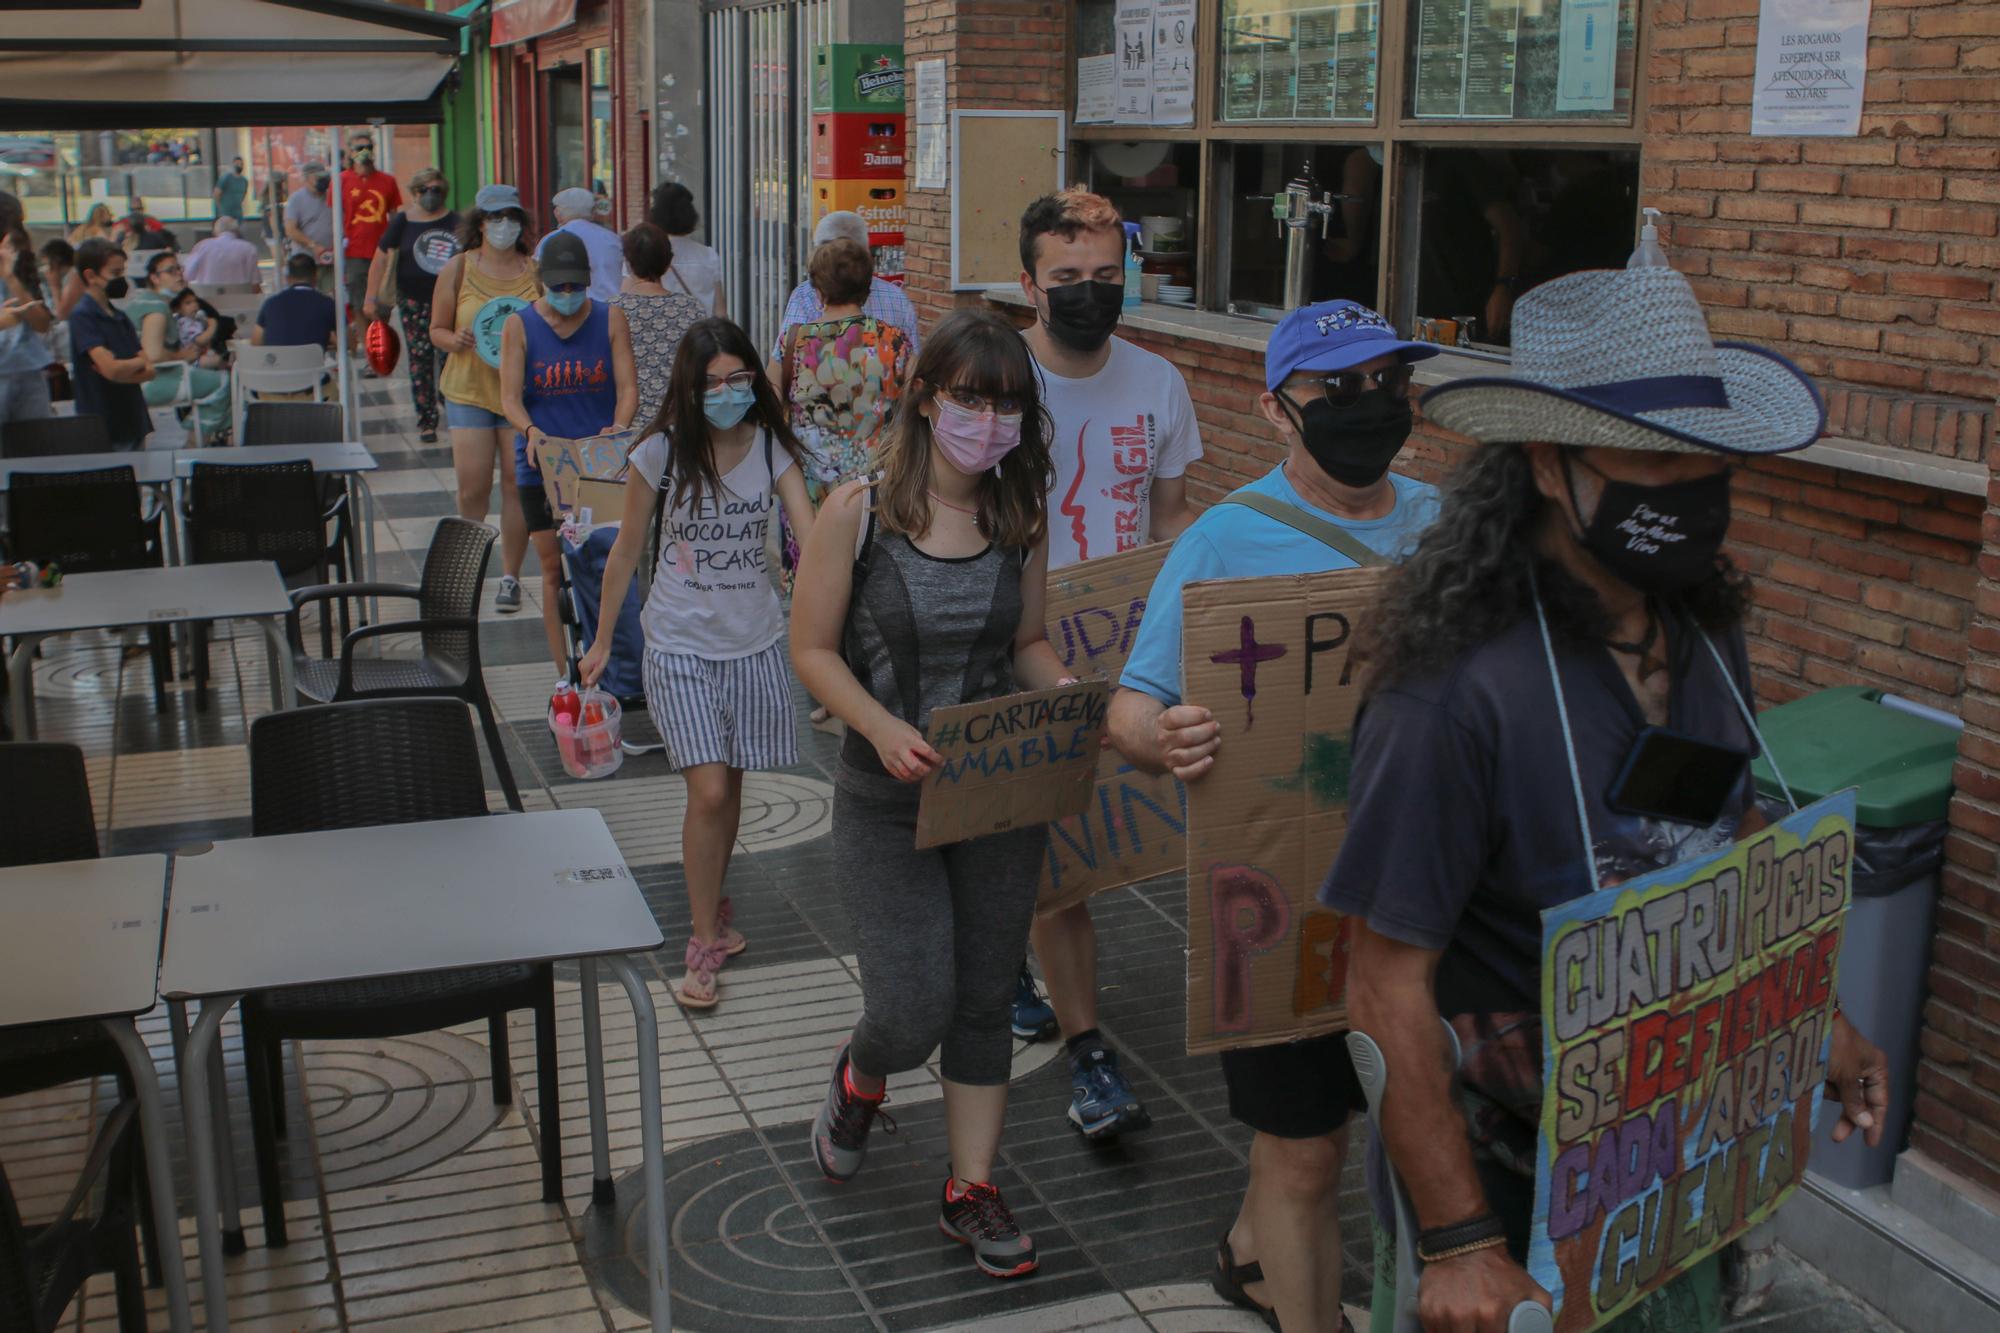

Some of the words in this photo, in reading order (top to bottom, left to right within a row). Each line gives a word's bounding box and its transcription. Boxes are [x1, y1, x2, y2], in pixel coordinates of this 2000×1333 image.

[1781, 35, 1795, 47] LES
[1797, 32, 1842, 46] ROGAMOS
[1825, 51, 1841, 62] SER
[1771, 70, 1824, 82] ATENDIDOS
[1824, 69, 1847, 80] PARA
[1785, 88, 1828, 99] SENTARSE
[864, 153, 902, 166] Damm
[724, 492, 769, 515] and
[934, 692, 1106, 748] #CARTAGENA
[935, 724, 1091, 786] AMABLE
[1554, 866, 1742, 1043] CUATRO
[1743, 830, 1848, 961] PICOS
[1557, 1026, 1626, 1146] SE
[1625, 925, 1840, 1112] DEFIENDE
[1547, 1099, 1677, 1241] CADA
[1597, 1109, 1794, 1312] CUENTA
